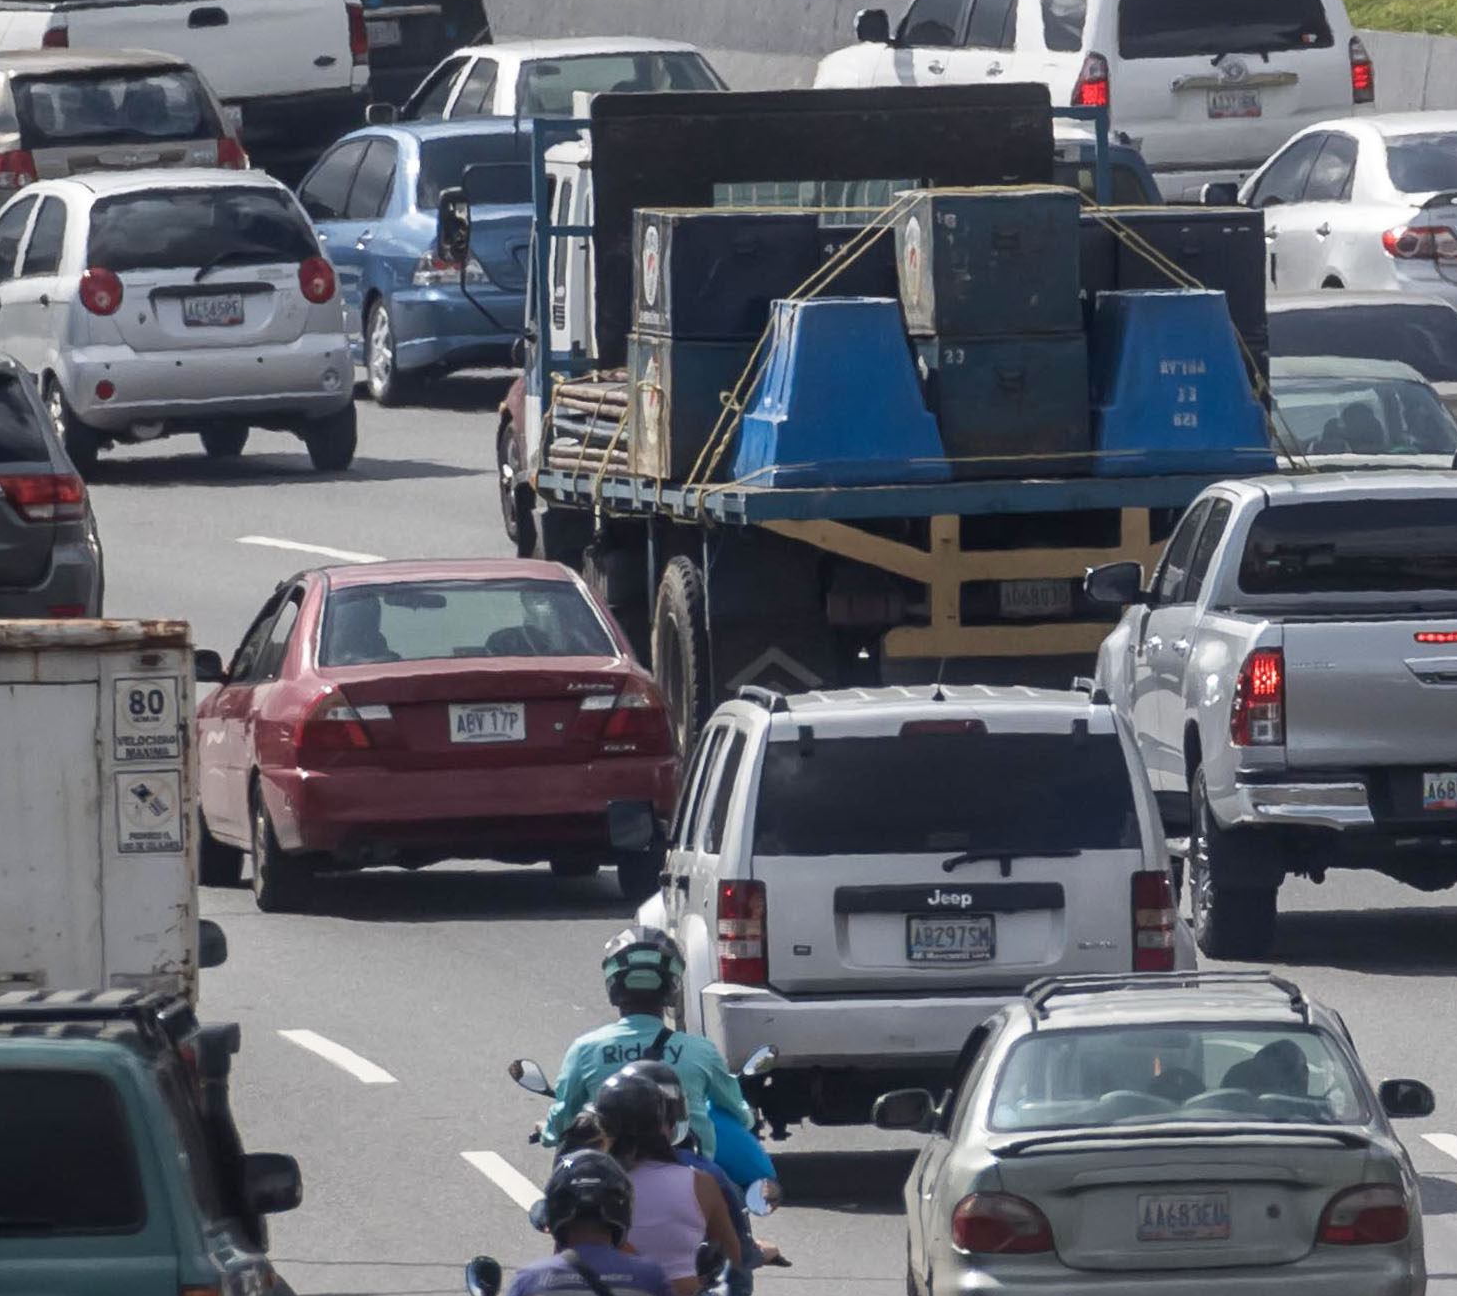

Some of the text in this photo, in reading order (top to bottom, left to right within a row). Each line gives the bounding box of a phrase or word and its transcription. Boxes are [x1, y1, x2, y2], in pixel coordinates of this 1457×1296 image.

[944, 349, 968, 364] 23
[127, 689, 165, 715] 80
[456, 709, 518, 734] ABV 17P
[927, 889, 972, 908] Jeep
[603, 1040, 683, 1065] Ridry
